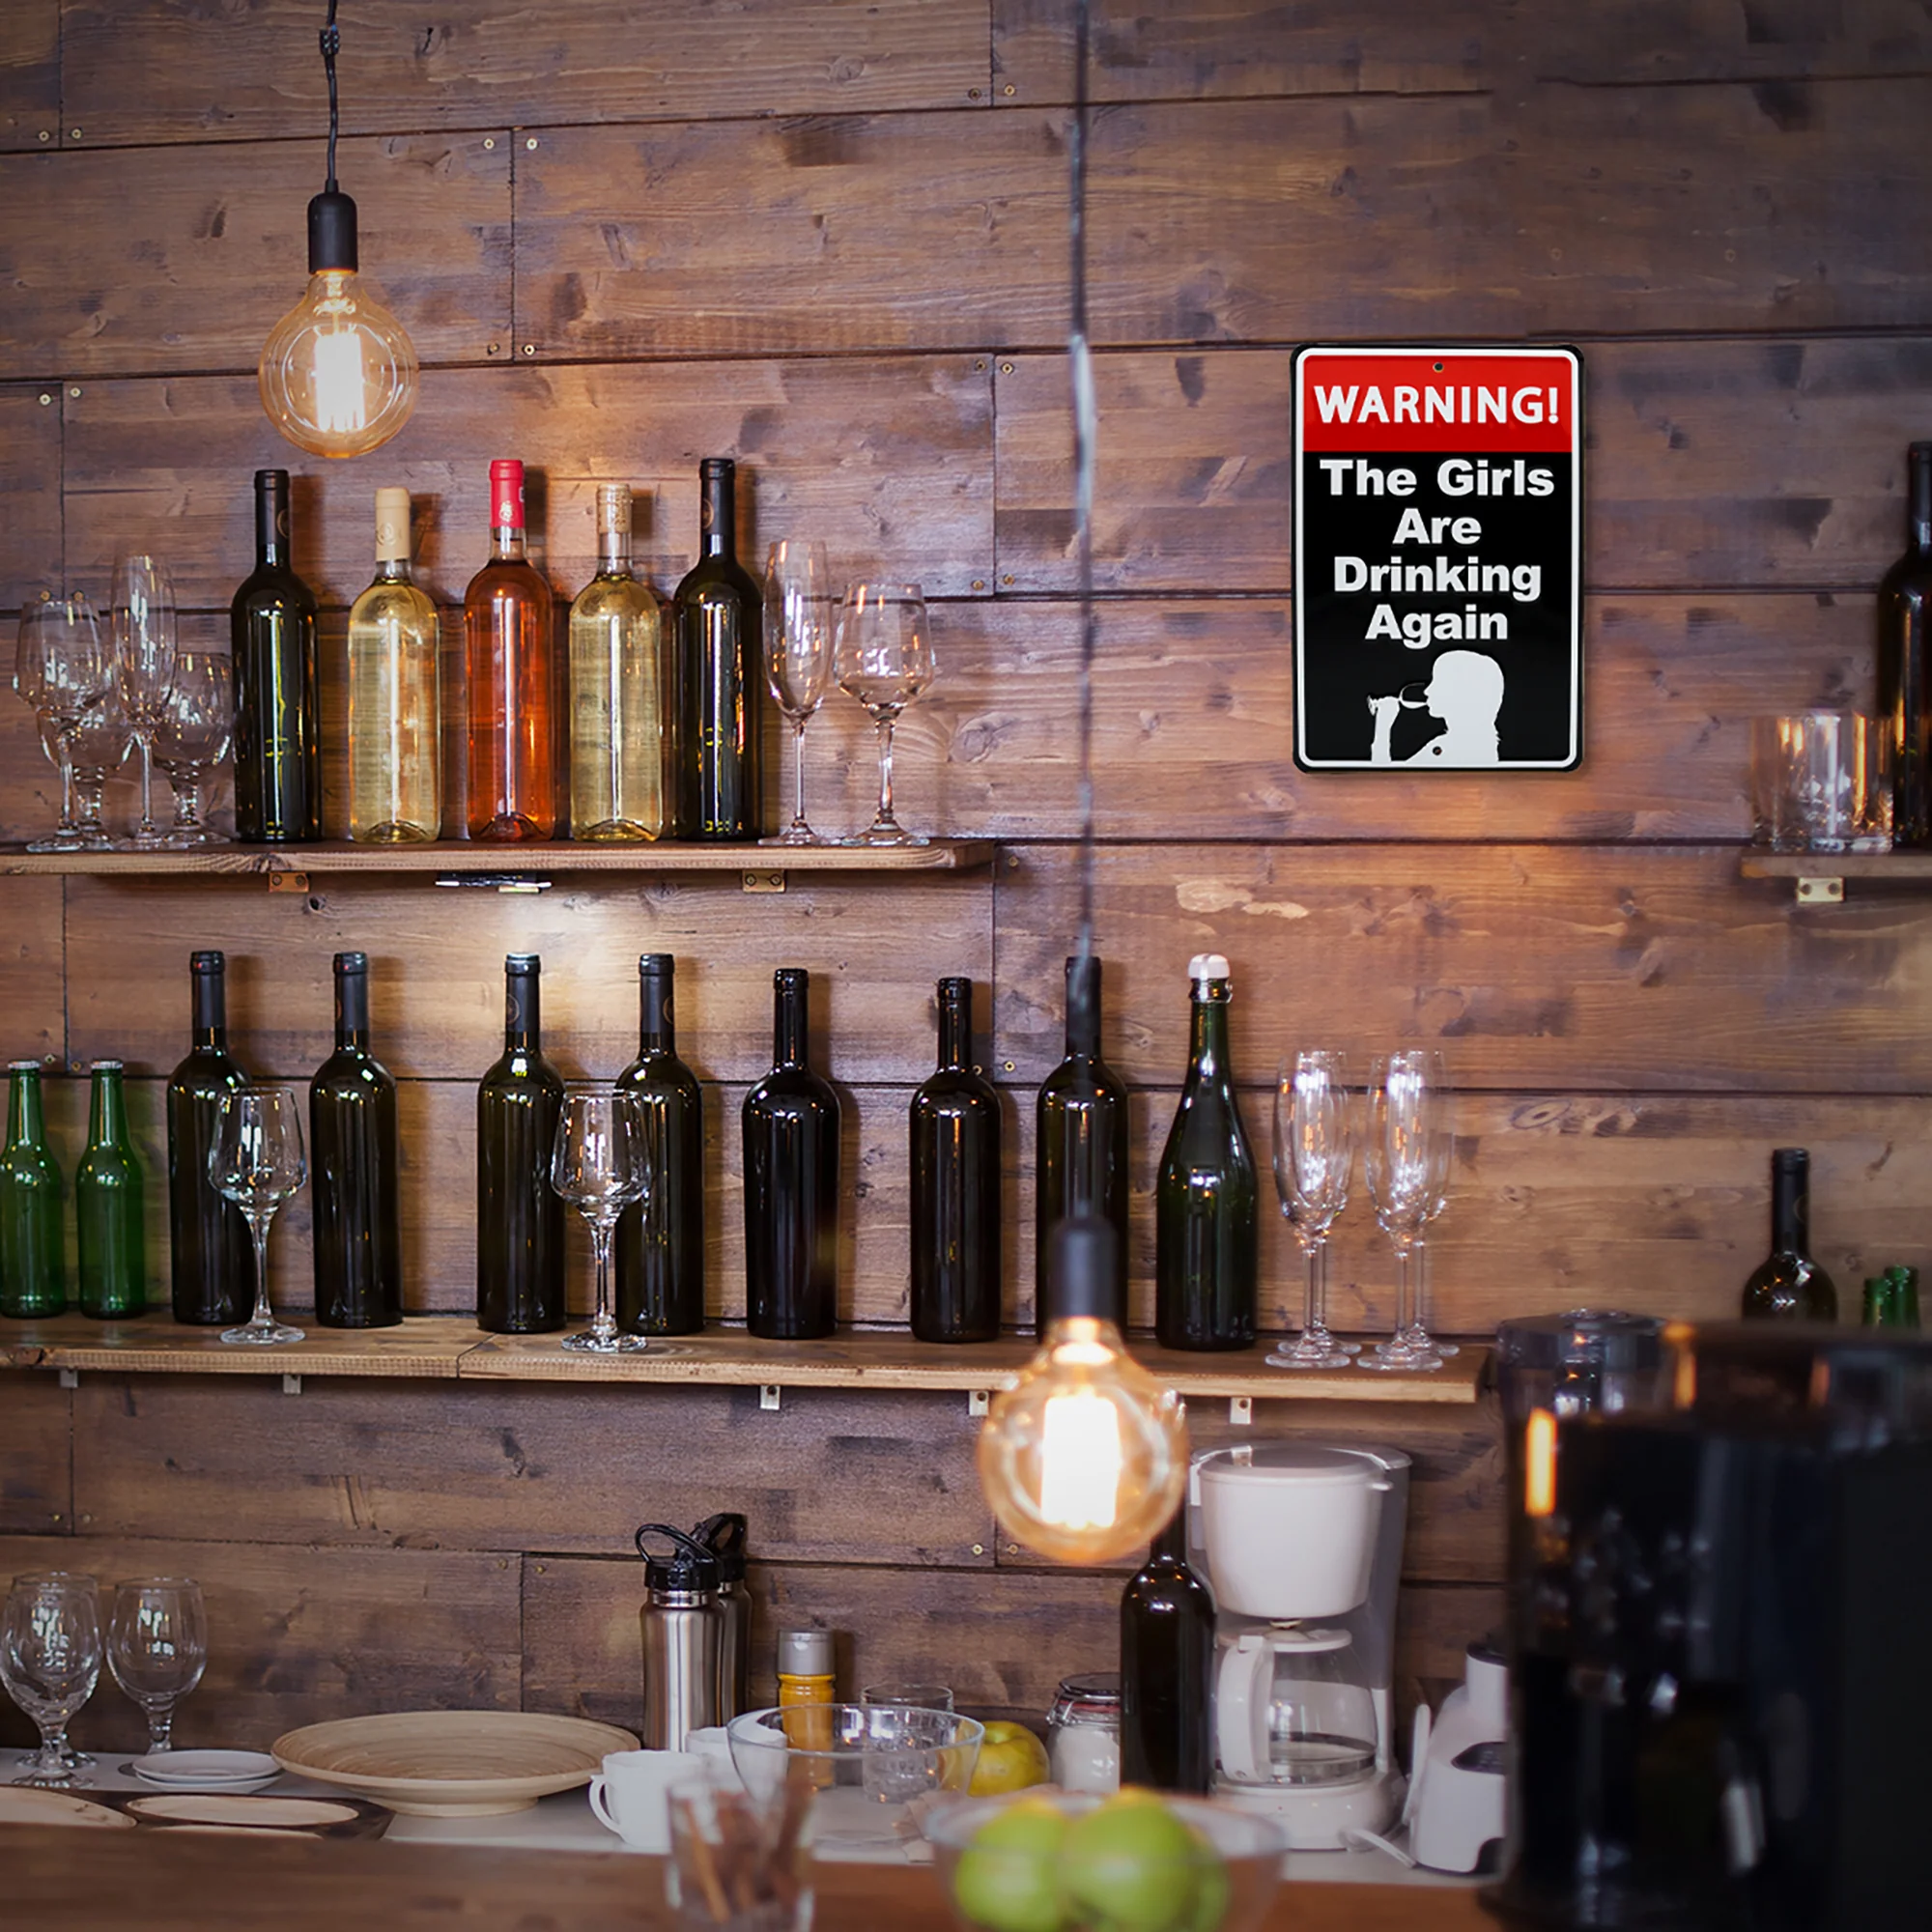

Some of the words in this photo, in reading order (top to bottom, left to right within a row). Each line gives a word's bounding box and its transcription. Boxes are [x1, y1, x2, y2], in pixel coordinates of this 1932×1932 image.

[1314, 385, 1559, 424] WARNING!
[1320, 459, 1417, 497] The
[1436, 459, 1554, 497] Girls
[1392, 507, 1482, 545] Are
[1334, 555, 1541, 602] Drinking
[1364, 604, 1508, 649] Again
